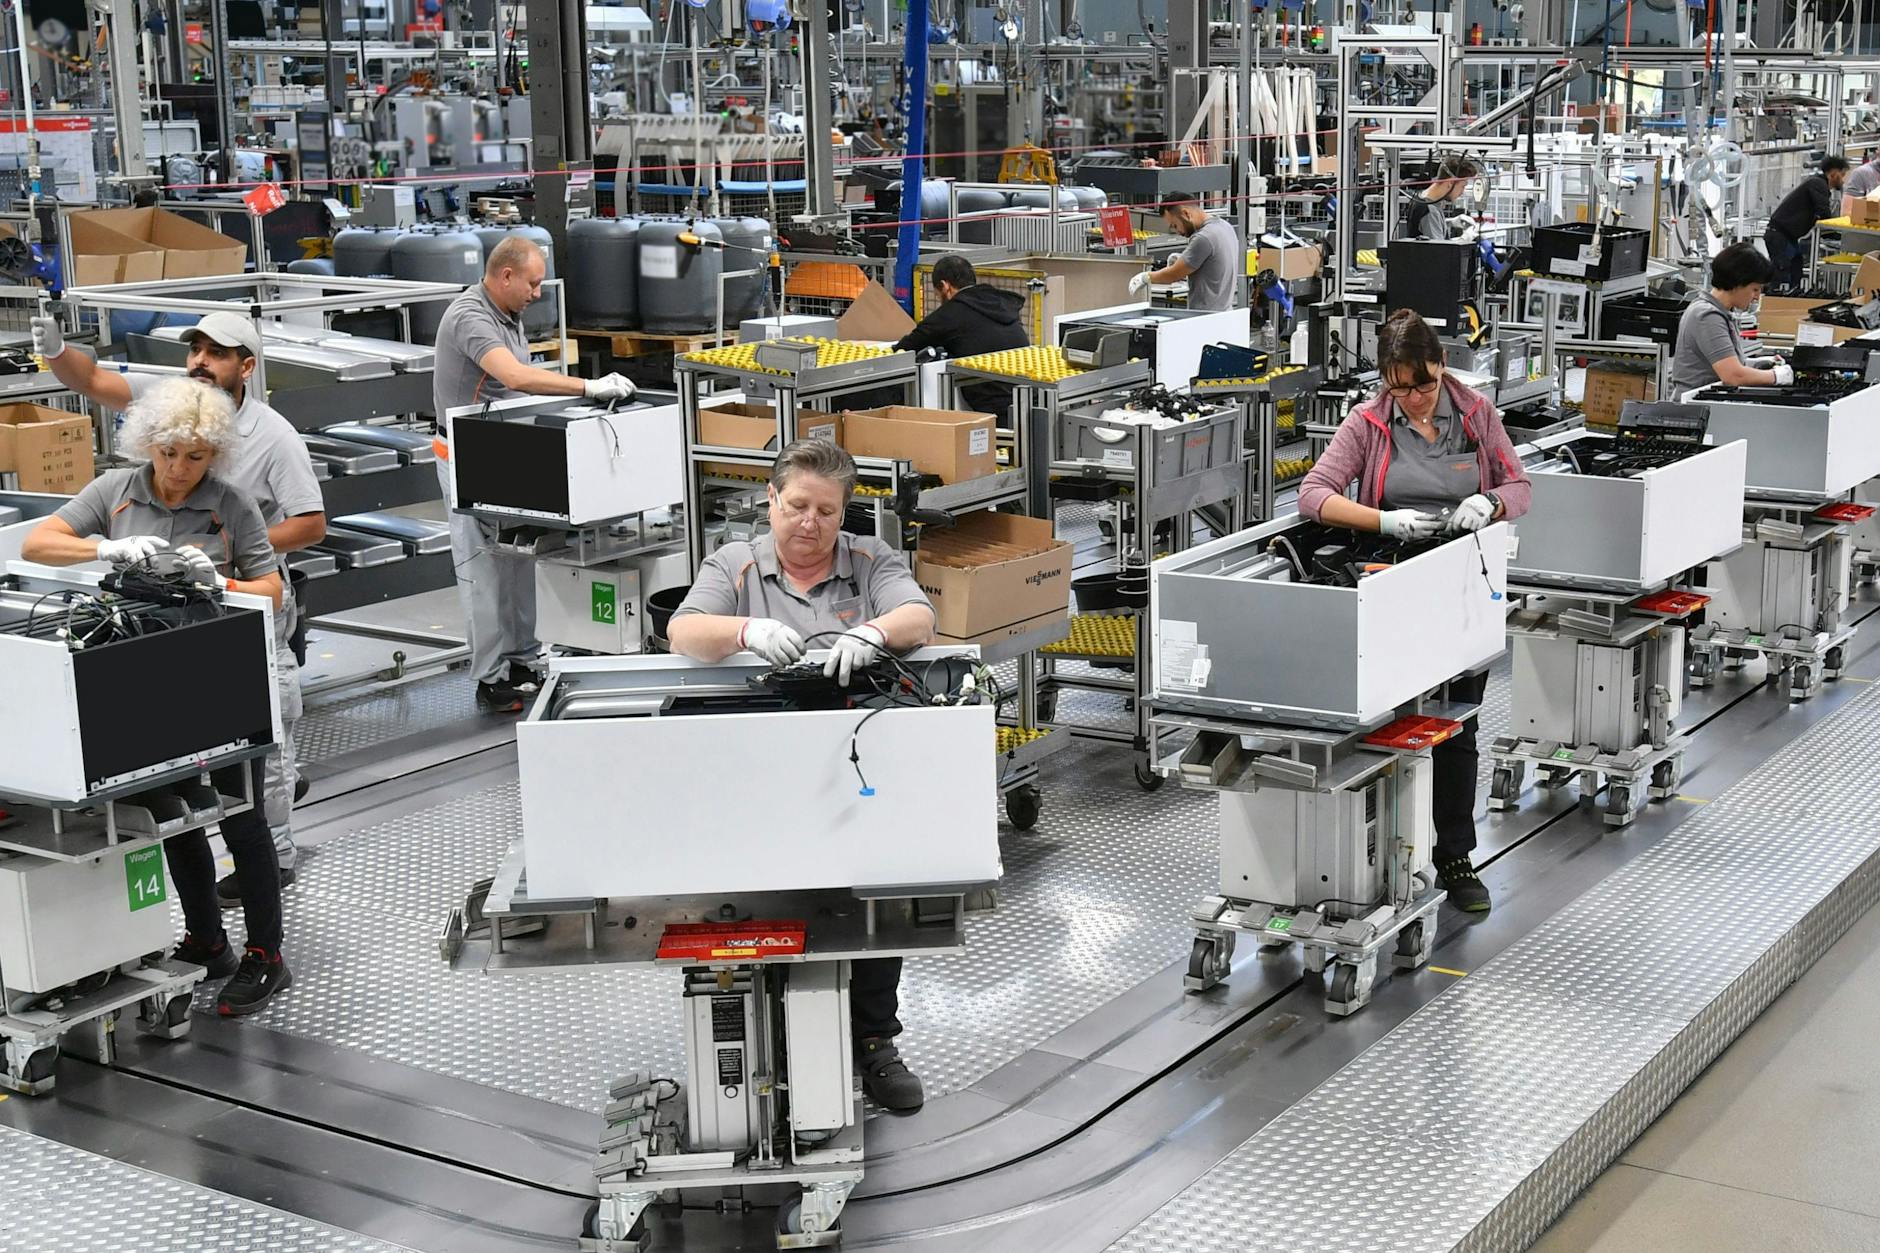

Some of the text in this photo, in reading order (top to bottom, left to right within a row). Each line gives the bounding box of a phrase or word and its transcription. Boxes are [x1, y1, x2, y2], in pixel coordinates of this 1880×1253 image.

[1025, 568, 1062, 586] VIESSMANN
[594, 584, 612, 593] Wagen
[595, 601, 613, 619] 12
[129, 849, 157, 863] Wagen
[134, 873, 160, 901] 14
